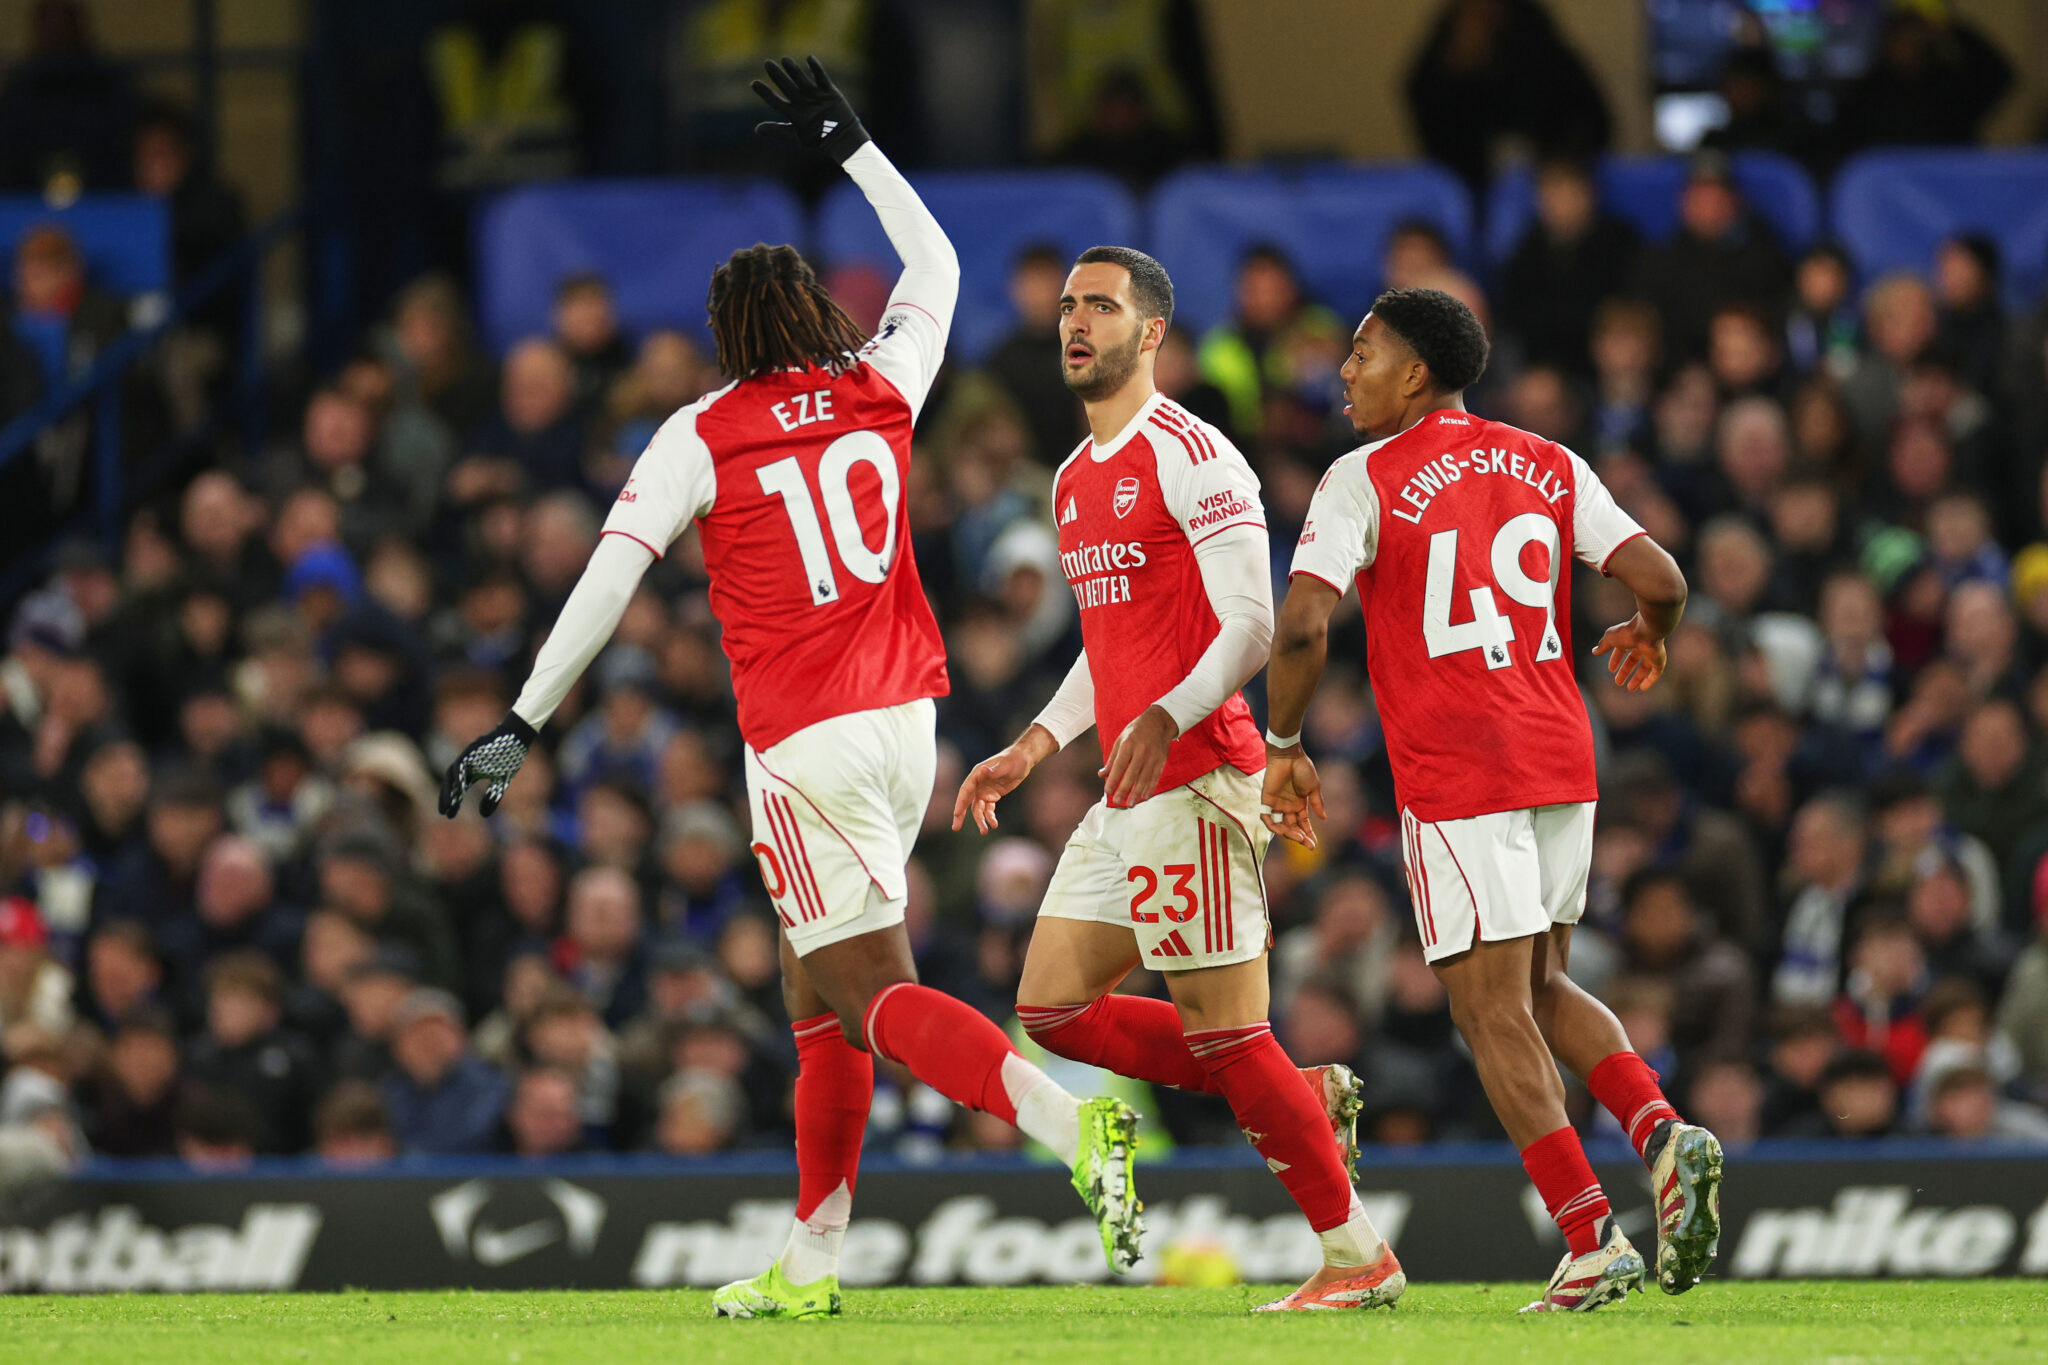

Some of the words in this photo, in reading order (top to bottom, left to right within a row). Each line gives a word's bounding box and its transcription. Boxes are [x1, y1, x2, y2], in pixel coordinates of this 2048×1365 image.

[770, 389, 835, 432] EZE
[755, 430, 900, 607] 10
[1188, 499, 1254, 532] RWANDA
[1197, 489, 1234, 512] VISIT
[1392, 448, 1570, 525] LEWIS-SKELLY
[1058, 538, 1147, 580] mirates
[1085, 574, 1132, 609] BETTER
[1422, 512, 1562, 672] 49
[1127, 863, 1199, 923] 23
[0, 1203, 323, 1290] otball
[913, 1193, 1411, 1285] footbal
[1730, 1185, 2017, 1278] nike
